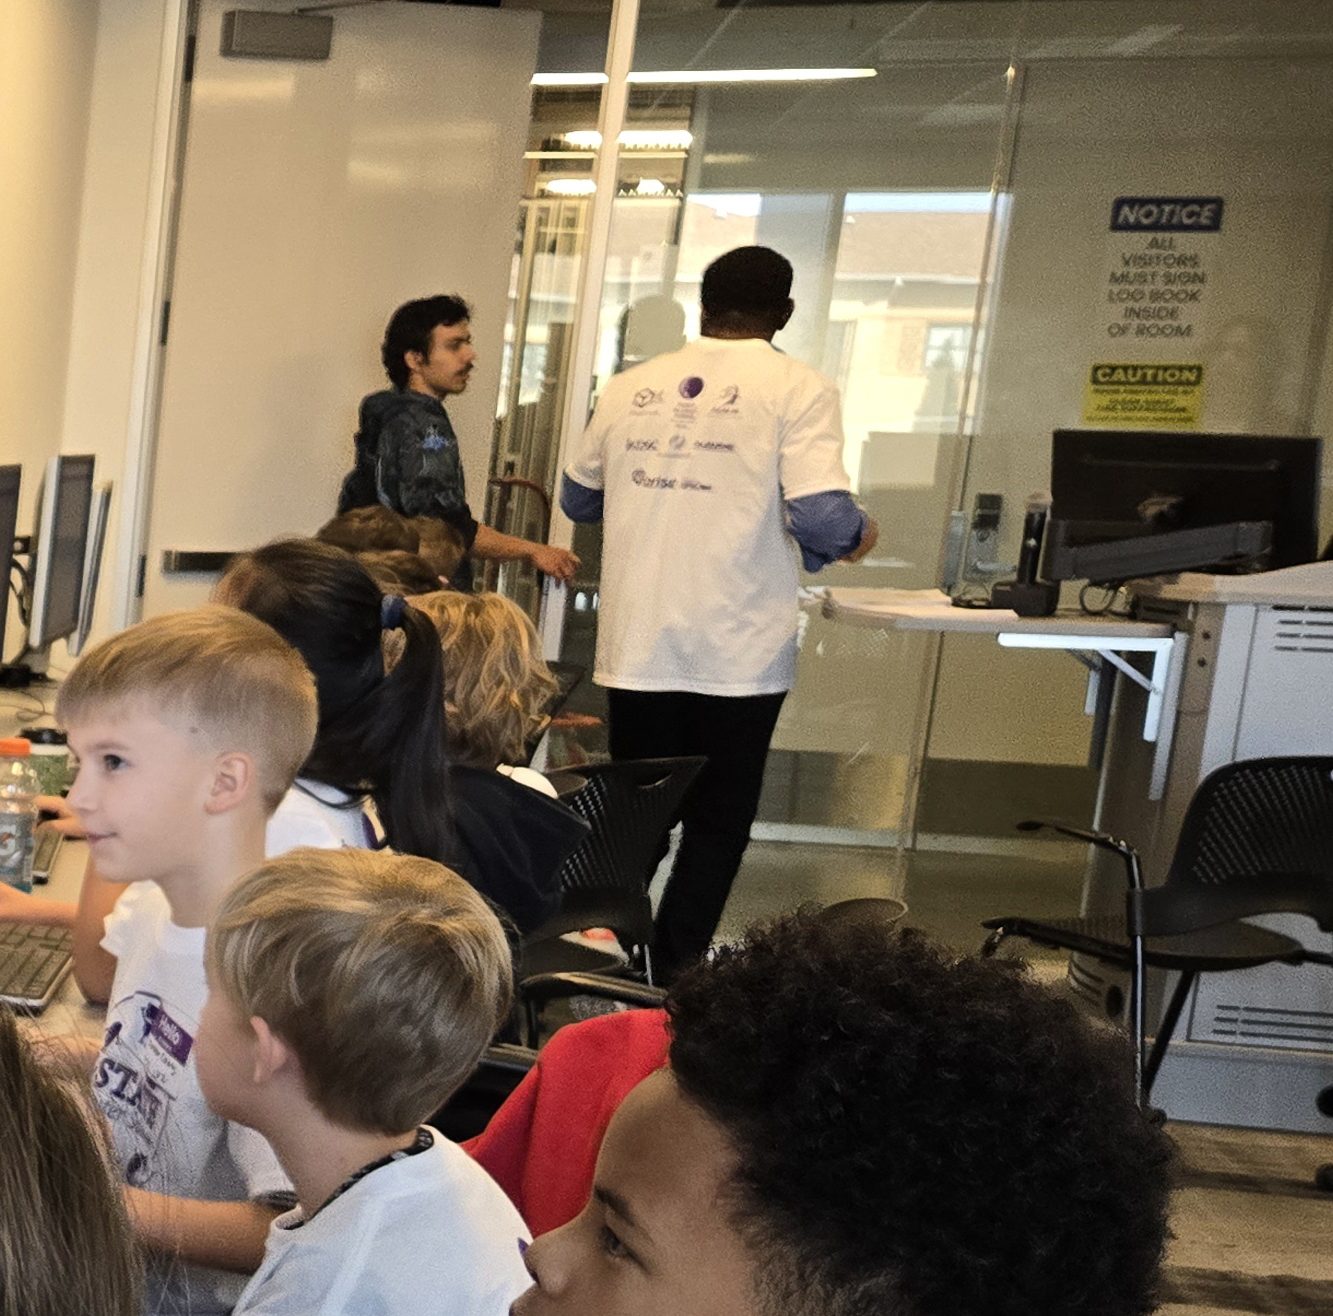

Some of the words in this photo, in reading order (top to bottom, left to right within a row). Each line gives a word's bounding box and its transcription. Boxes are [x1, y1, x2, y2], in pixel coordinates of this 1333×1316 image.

[1117, 203, 1217, 225] NOTICE
[1146, 236, 1175, 250] ALL
[1121, 252, 1199, 268] VISITORS
[1109, 271, 1157, 285] MUST
[1163, 271, 1205, 285] SIGN
[1148, 288, 1201, 304] BOOK
[1123, 306, 1180, 320] INSIDE
[1107, 322, 1132, 337] OF
[1135, 323, 1193, 338] ROOM
[1096, 366, 1199, 383] CAUTION
